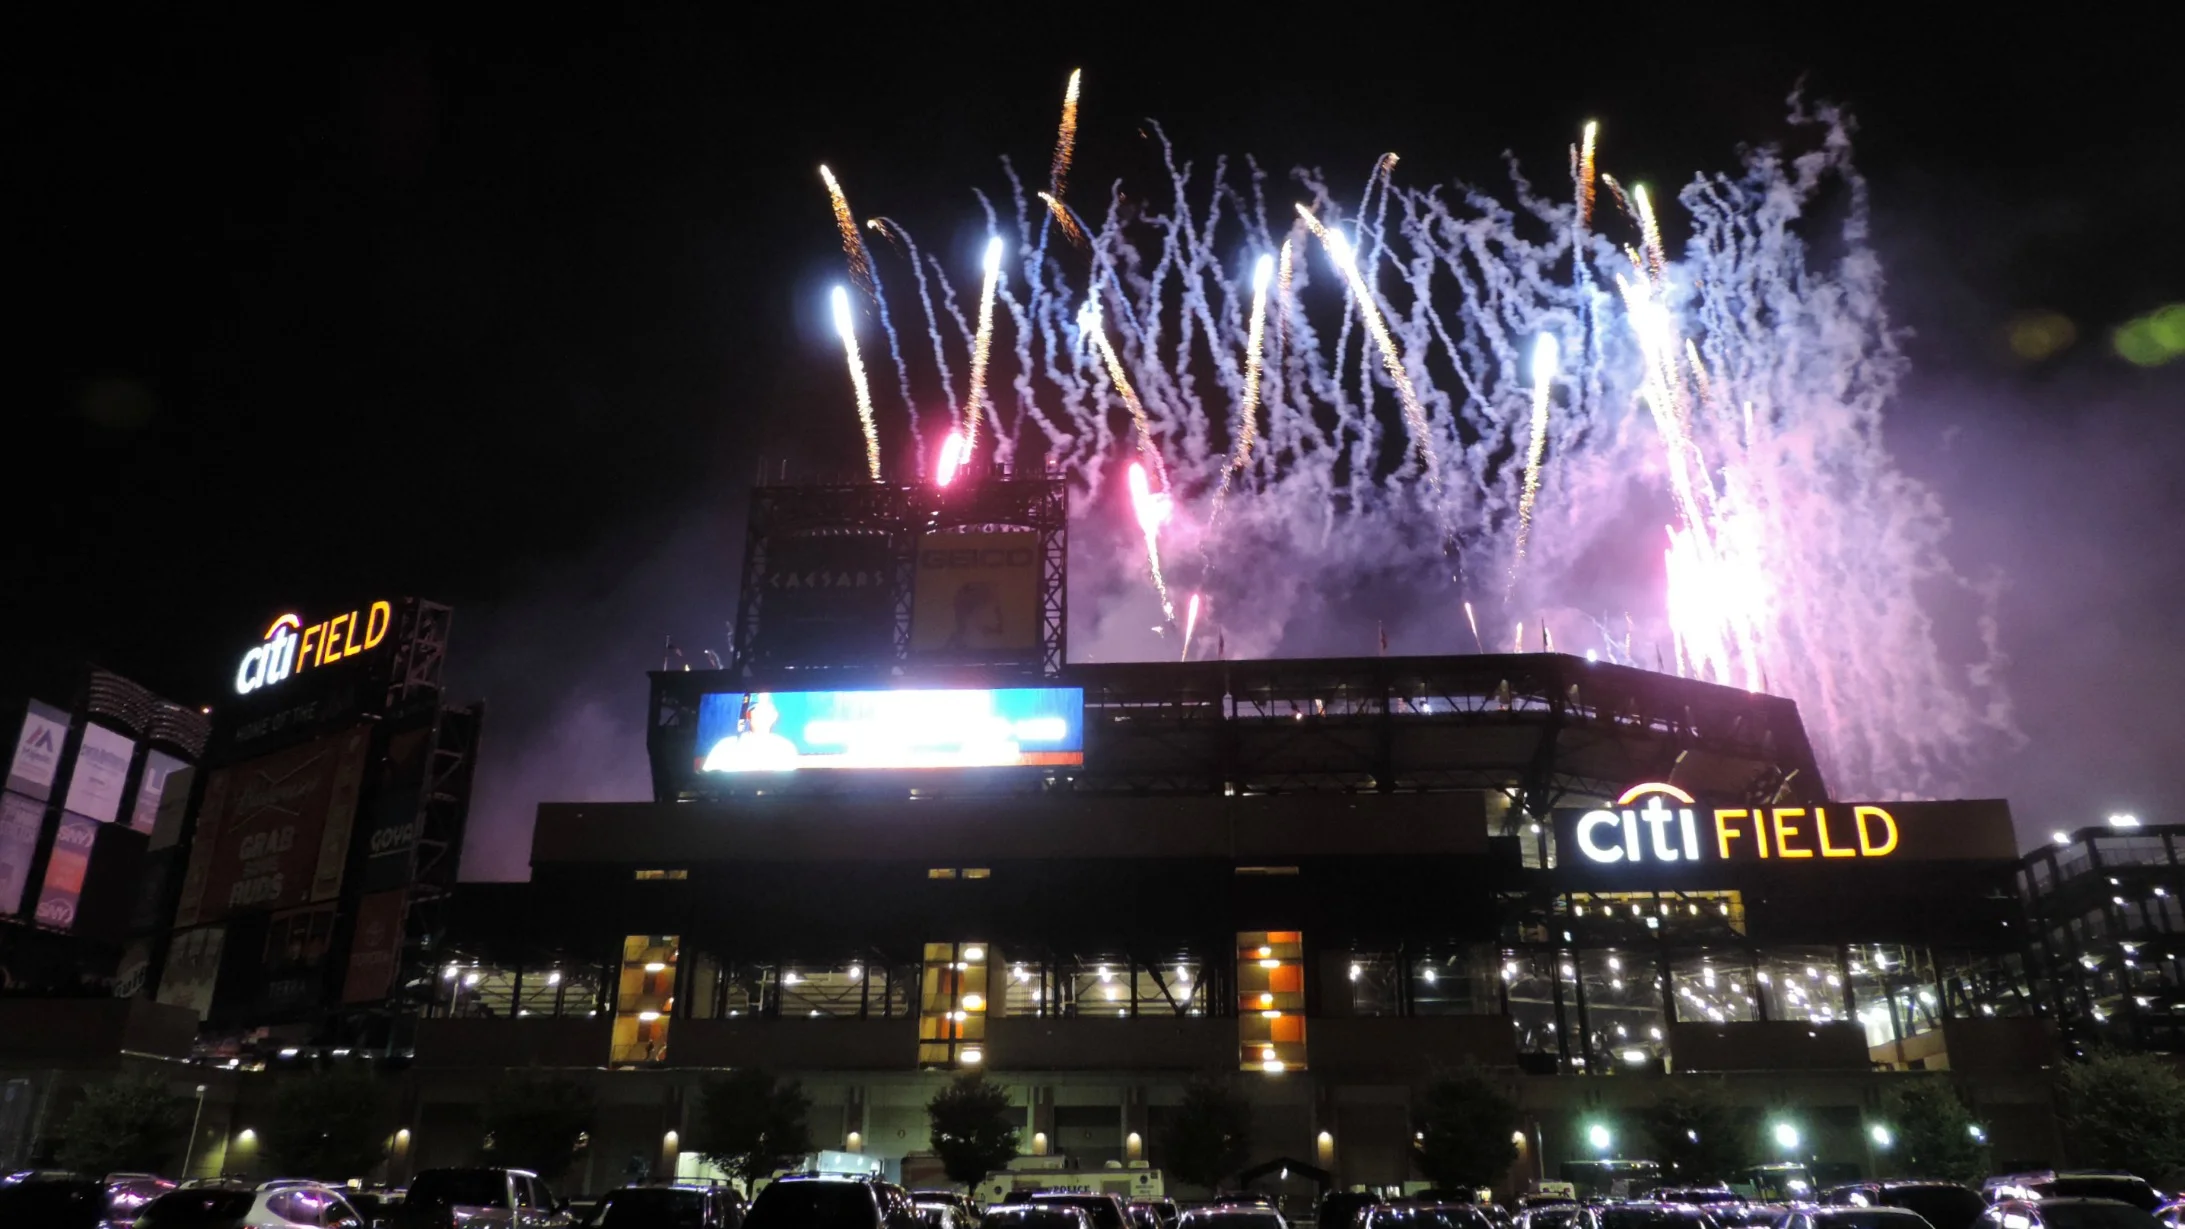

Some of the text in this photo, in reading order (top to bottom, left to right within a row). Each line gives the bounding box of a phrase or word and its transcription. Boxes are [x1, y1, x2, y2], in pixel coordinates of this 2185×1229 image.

[920, 549, 1034, 569] GEICO
[768, 571, 884, 589] CAESARS
[236, 600, 391, 695] citi FIELD
[238, 825, 296, 862] GRAB
[1576, 795, 1899, 863] citi FIELD
[228, 872, 285, 909] BUDS
[36, 899, 74, 924] SNY
[1053, 1185, 1091, 1193] POLICE
